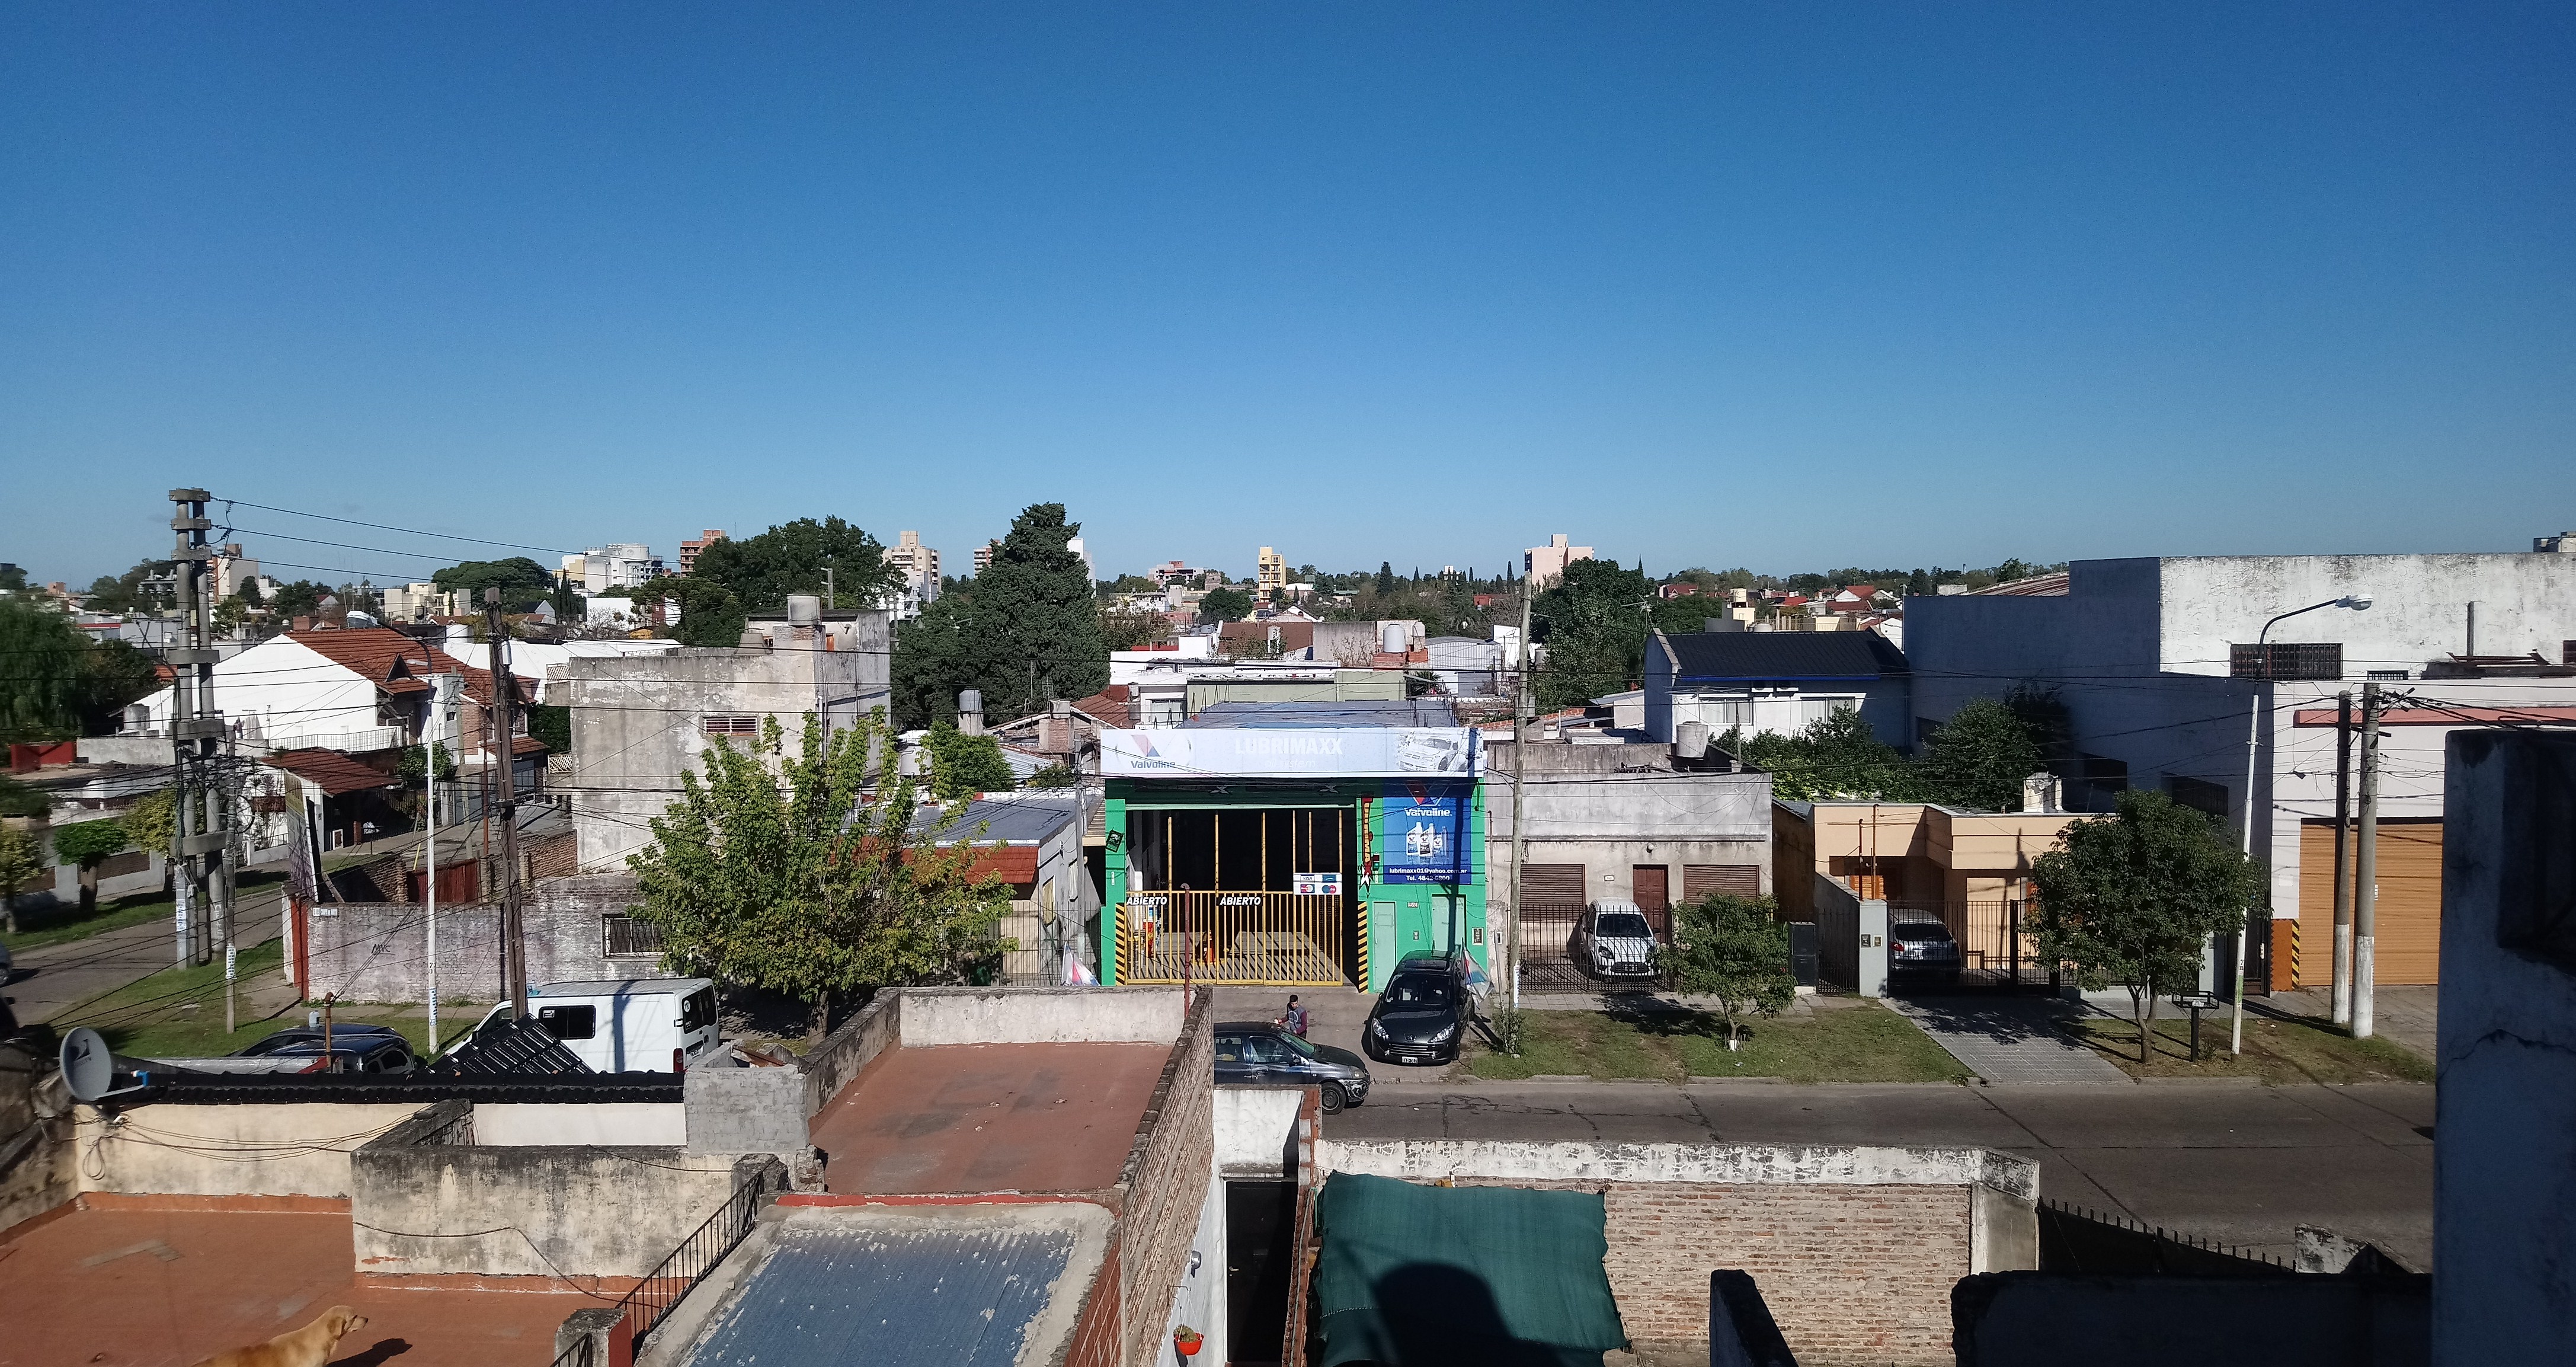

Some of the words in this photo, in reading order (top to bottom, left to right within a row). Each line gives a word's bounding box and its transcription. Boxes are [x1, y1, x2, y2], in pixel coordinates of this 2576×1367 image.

[1235, 737, 1343, 754] LUBRIMAXX
[1127, 897, 1167, 905] ABIERTO
[1220, 897, 1261, 905] ABIERTO
